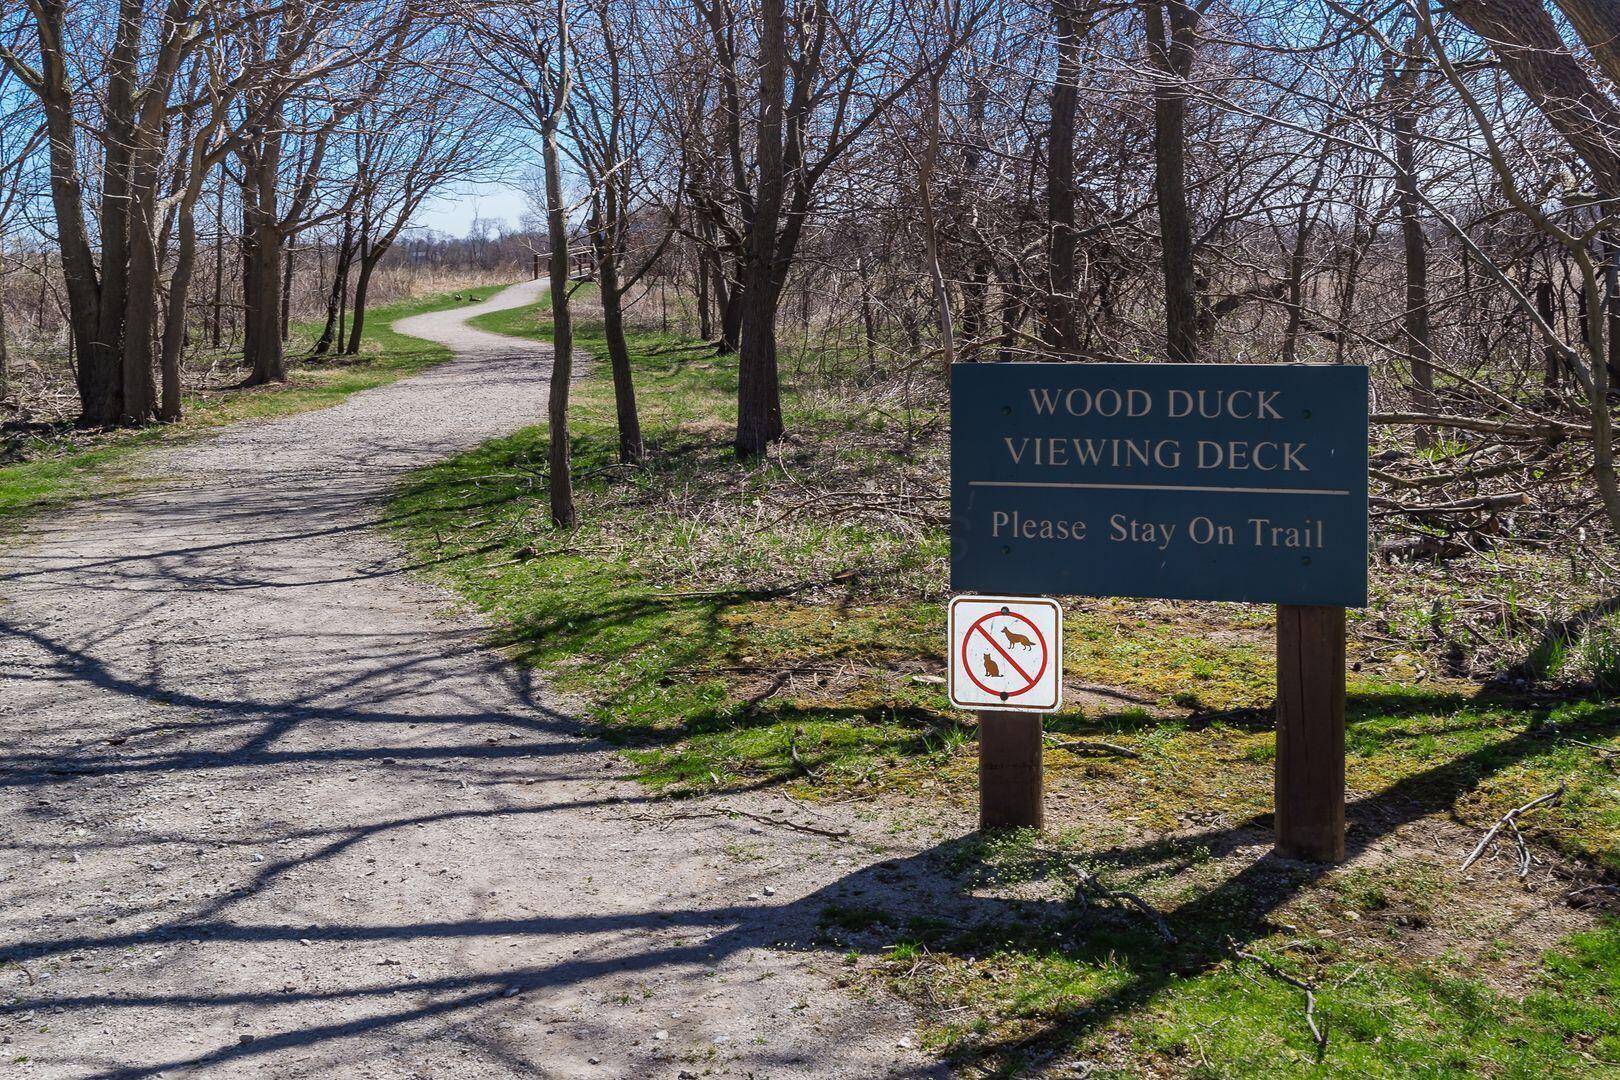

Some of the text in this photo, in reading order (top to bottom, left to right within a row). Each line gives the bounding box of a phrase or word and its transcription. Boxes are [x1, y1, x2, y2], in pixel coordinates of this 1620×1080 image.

[1028, 388, 1284, 420] WOOD DUCK
[1004, 437, 1309, 472] VIEWING DECK
[992, 510, 1325, 551] Please Stay On Trail
